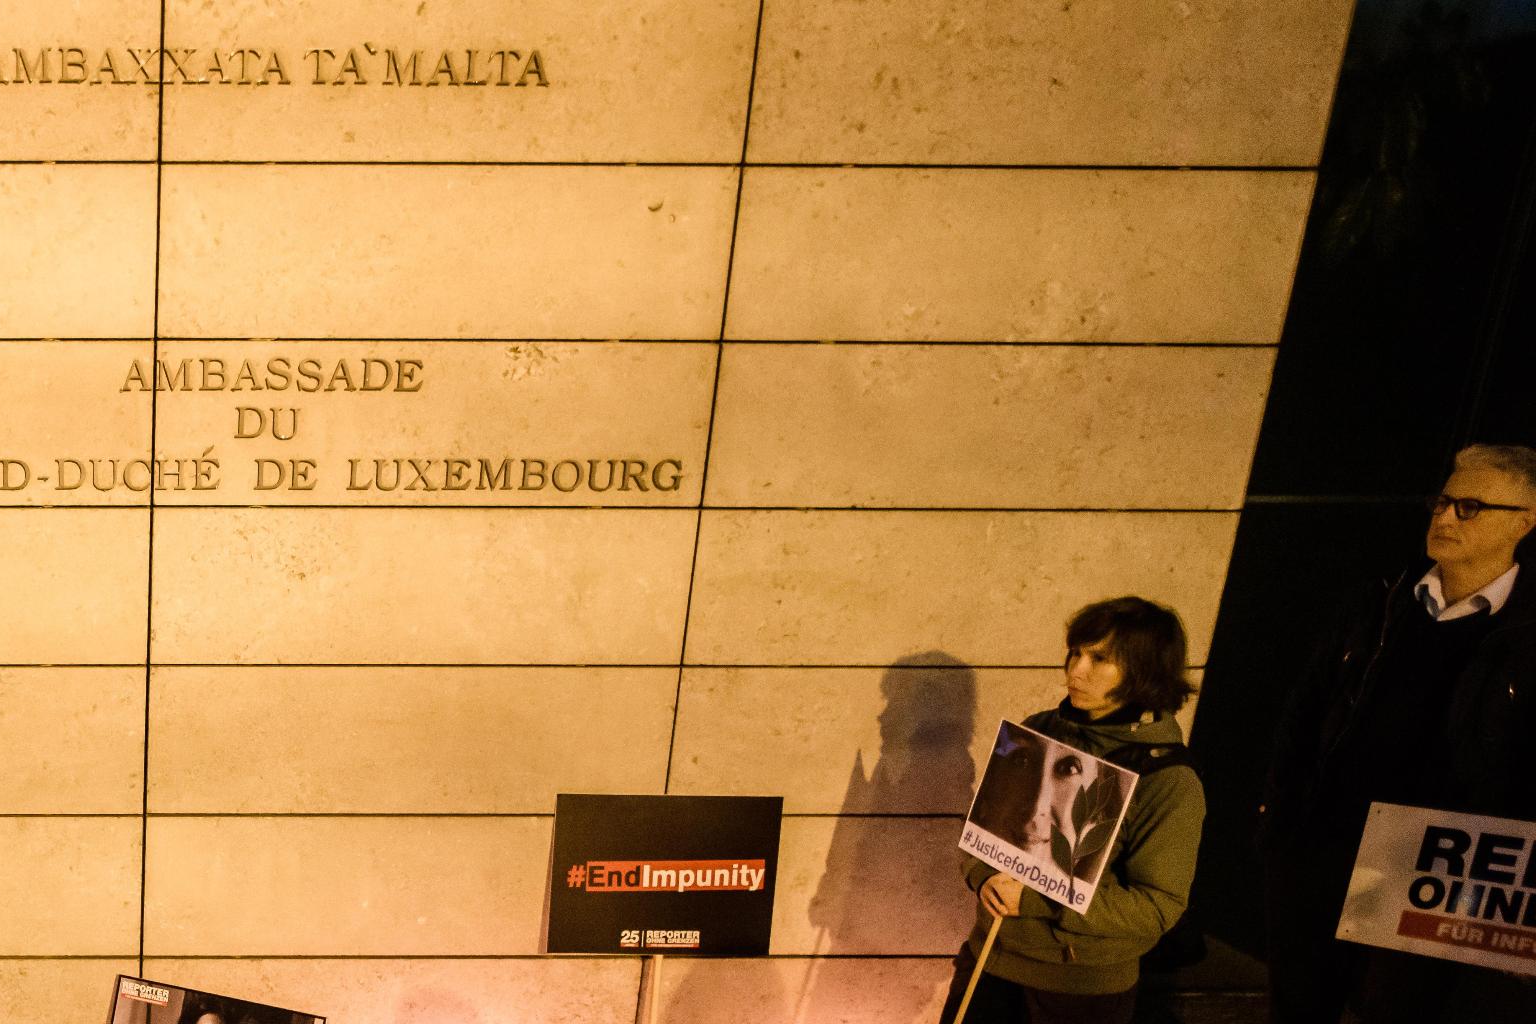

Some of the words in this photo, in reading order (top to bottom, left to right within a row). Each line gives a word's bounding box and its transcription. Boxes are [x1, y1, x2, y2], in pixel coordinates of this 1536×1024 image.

[120, 357, 424, 393] AMBASSADE
[234, 407, 301, 440] DU
[253, 458, 317, 491] DE
[346, 457, 685, 492] LUXEMBOURG
[567, 862, 765, 893] #EndImpunity
[620, 930, 640, 944] 25
[646, 930, 700, 939] REPORTER
[1490, 930, 1536, 954] INF
[121, 980, 170, 998] REPORTER
